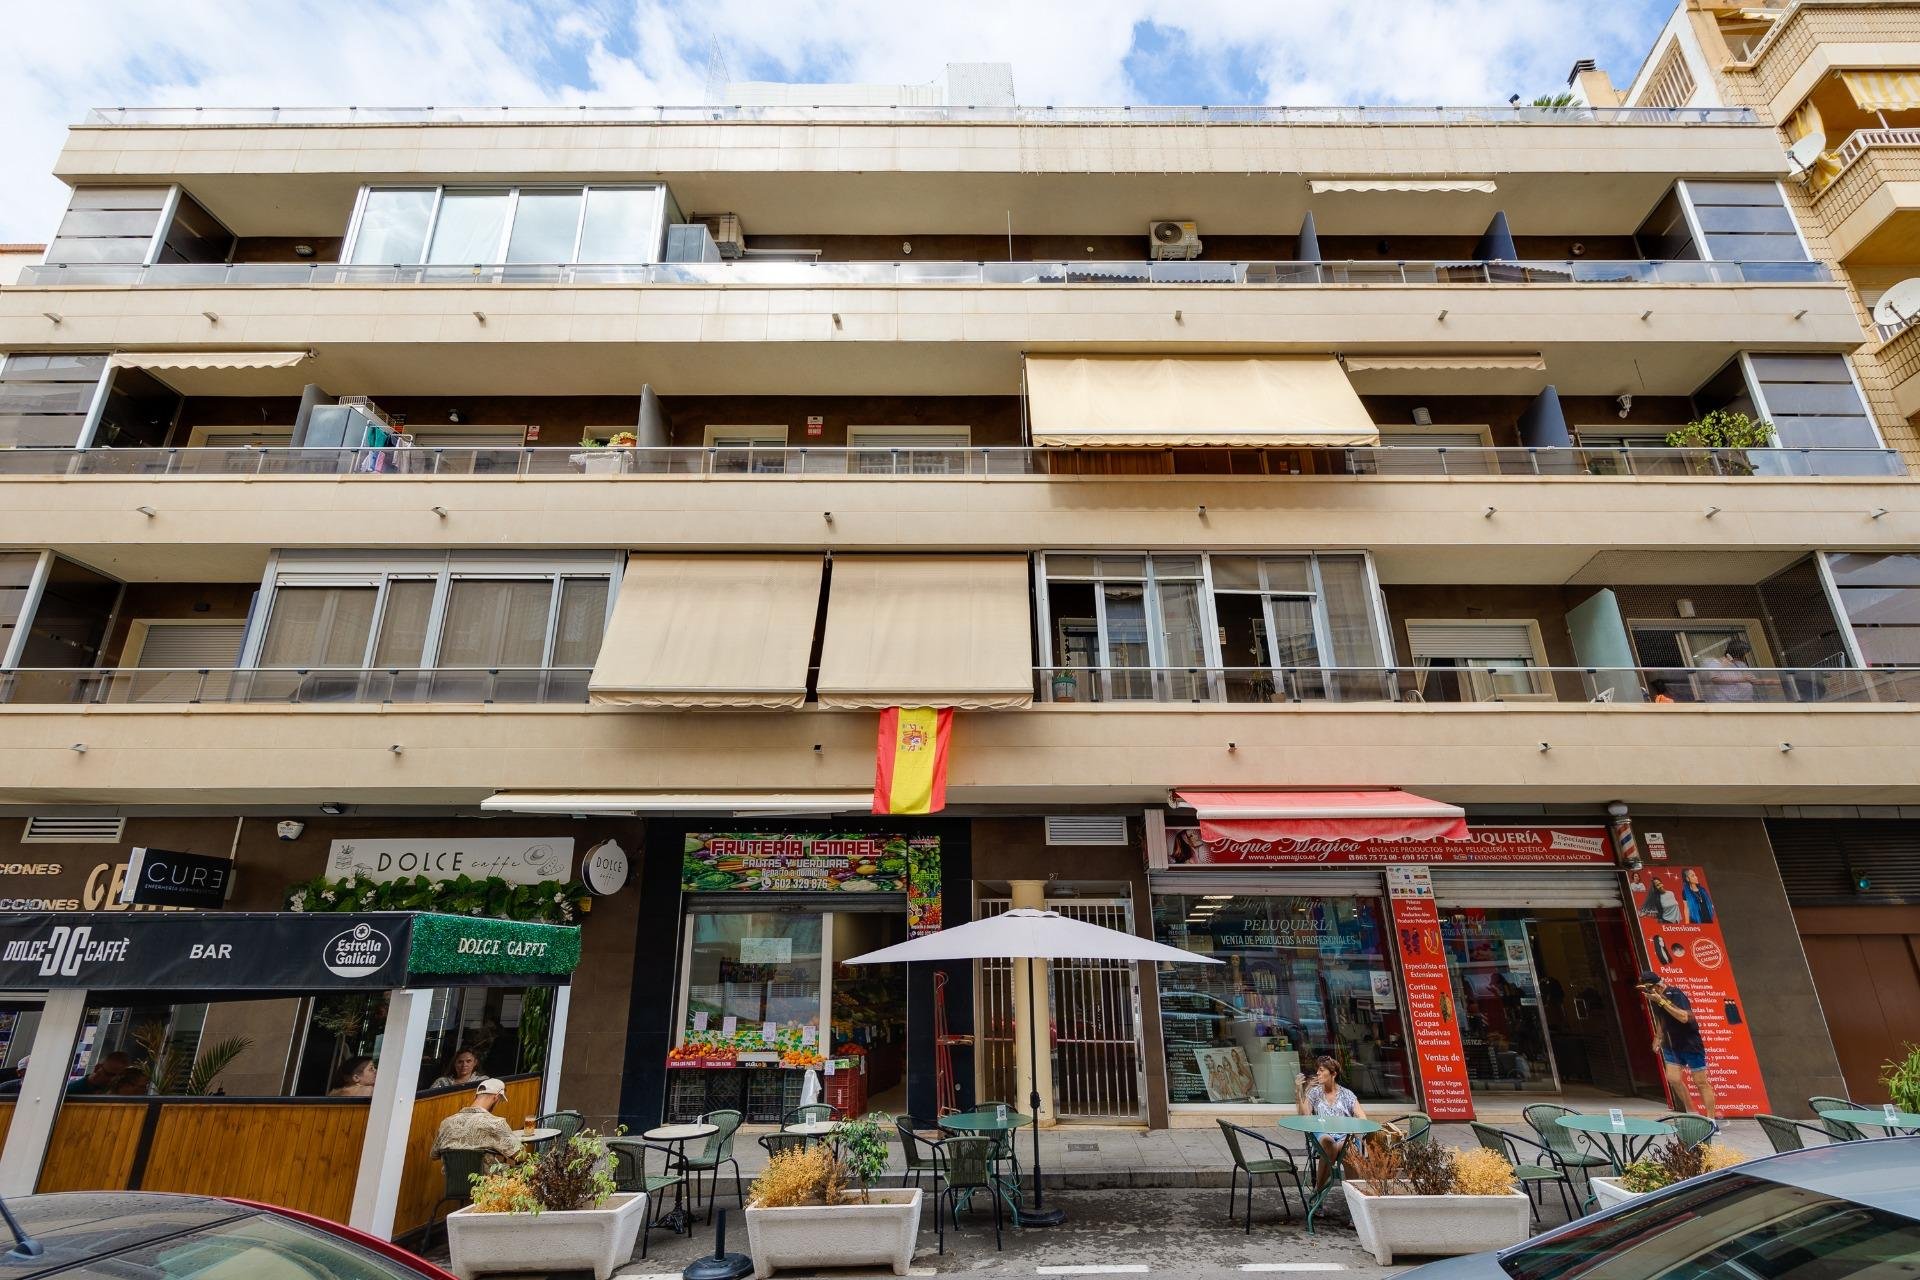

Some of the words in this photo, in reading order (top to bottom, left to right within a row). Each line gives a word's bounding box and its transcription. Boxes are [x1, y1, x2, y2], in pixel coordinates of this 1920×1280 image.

[710, 834, 804, 856] FRUTERÍA
[809, 840, 882, 856] ISMAEL
[1466, 845, 1508, 854] PELUQUERÍA
[376, 852, 463, 873] DOLCE
[1248, 854, 1316, 862] www.toquemagico.es
[596, 856, 622, 873] DOLCE
[742, 859, 781, 868] FRUTAS
[785, 859, 793, 868] Y
[797, 859, 849, 868] VERDURAS
[761, 868, 789, 878] Reparto
[796, 868, 829, 877] domicilio
[774, 878, 792, 888] 602
[793, 878, 810, 888] 329
[811, 878, 828, 888] 876
[1662, 924, 1701, 932] Extensiones
[1221, 935, 1243, 945] VENTA
[1244, 935, 1254, 945] DE
[1255, 935, 1295, 945] PRODUCTOS
[1295, 935, 1302, 945] A
[1302, 935, 1356, 945] PROFESIONALES
[3, 939, 48, 962] DOLCE
[335, 938, 382, 954] Estrella
[458, 937, 500, 956] DOLCE
[507, 939, 548, 957] CAFFE
[189, 943, 233, 960] BAR
[335, 951, 378, 966] Galicia
[1405, 963, 1438, 971] Especialista
[1660, 966, 1683, 974] Peluca
[1415, 1020, 1439, 1028] Grapas
[1424, 1053, 1449, 1061] Ventas
[1436, 1064, 1453, 1072] Pelo
